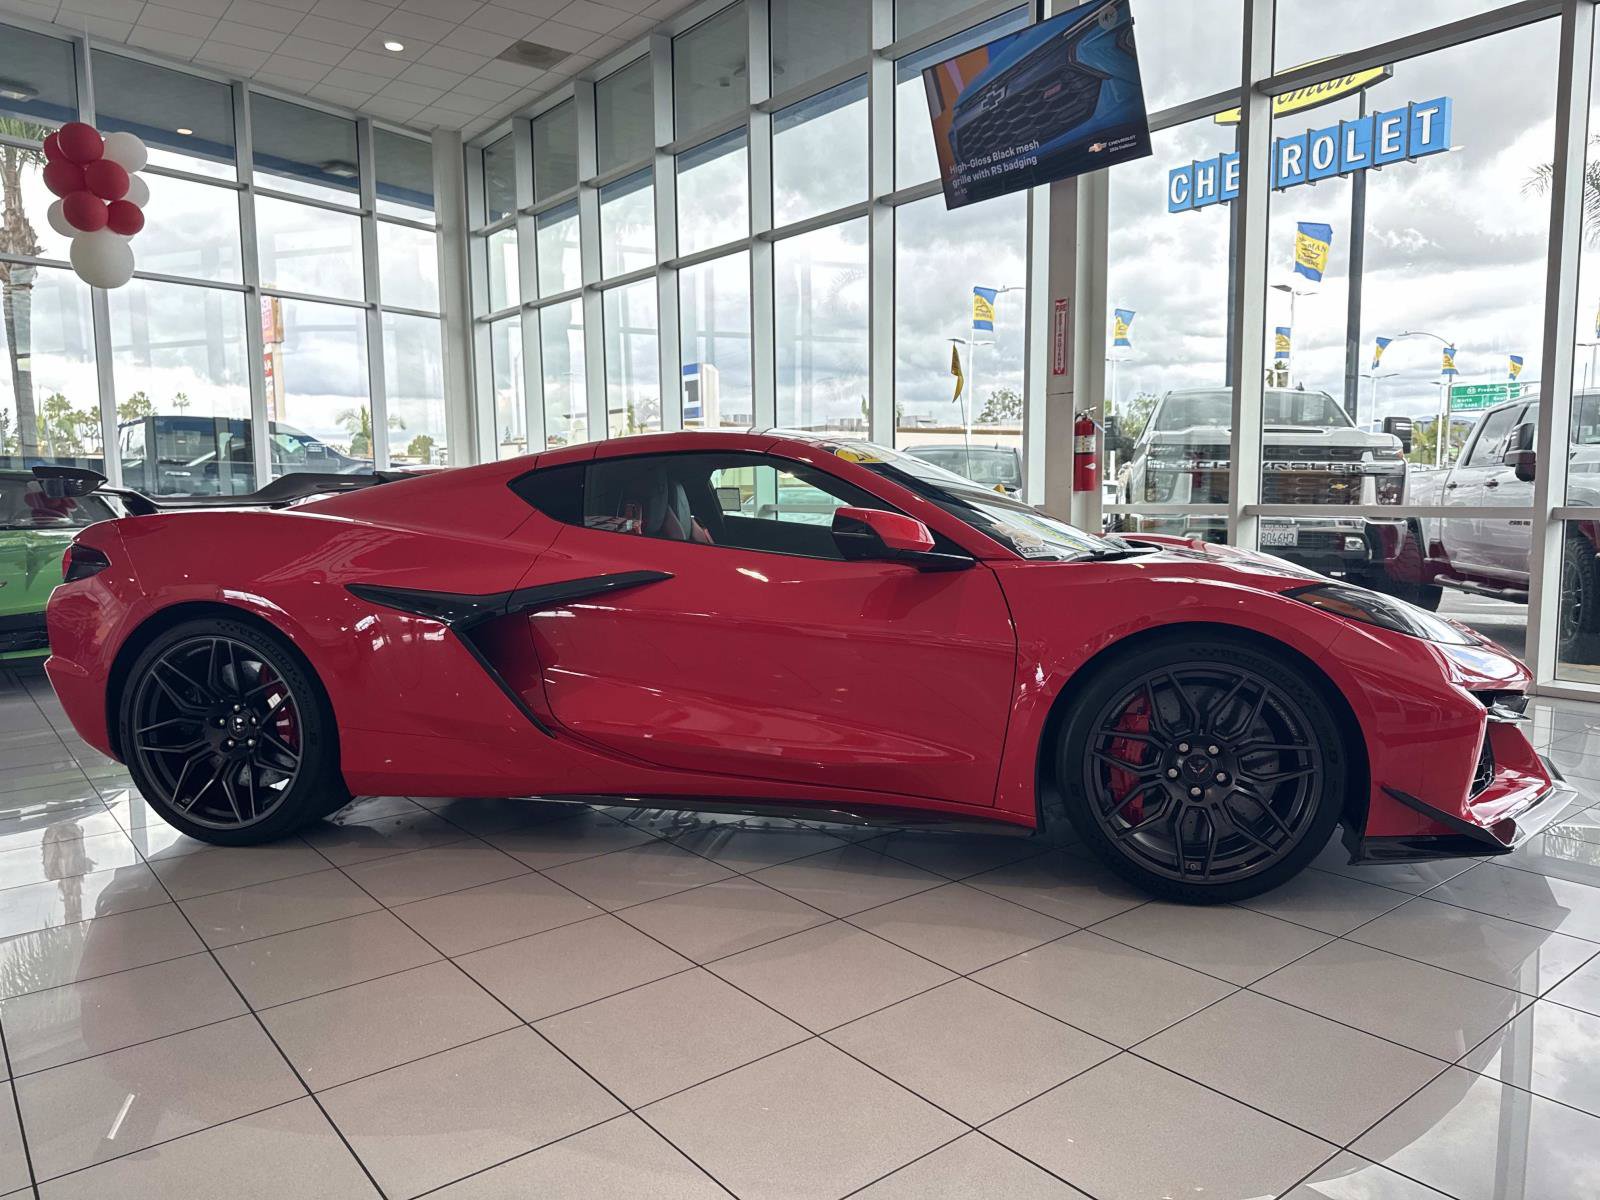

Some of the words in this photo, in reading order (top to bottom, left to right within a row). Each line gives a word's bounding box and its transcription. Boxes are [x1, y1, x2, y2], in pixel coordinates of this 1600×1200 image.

[949, 154, 992, 174] High-Gloss
[992, 146, 1015, 161] Black
[1016, 139, 1040, 155] mesh
[952, 174, 972, 189] grille
[972, 167, 990, 181] with
[990, 164, 1003, 176] RS
[1003, 155, 1038, 172] badging
[1169, 106, 1439, 204] CHEROLET
[1197, 461, 1362, 471] CHROLET
